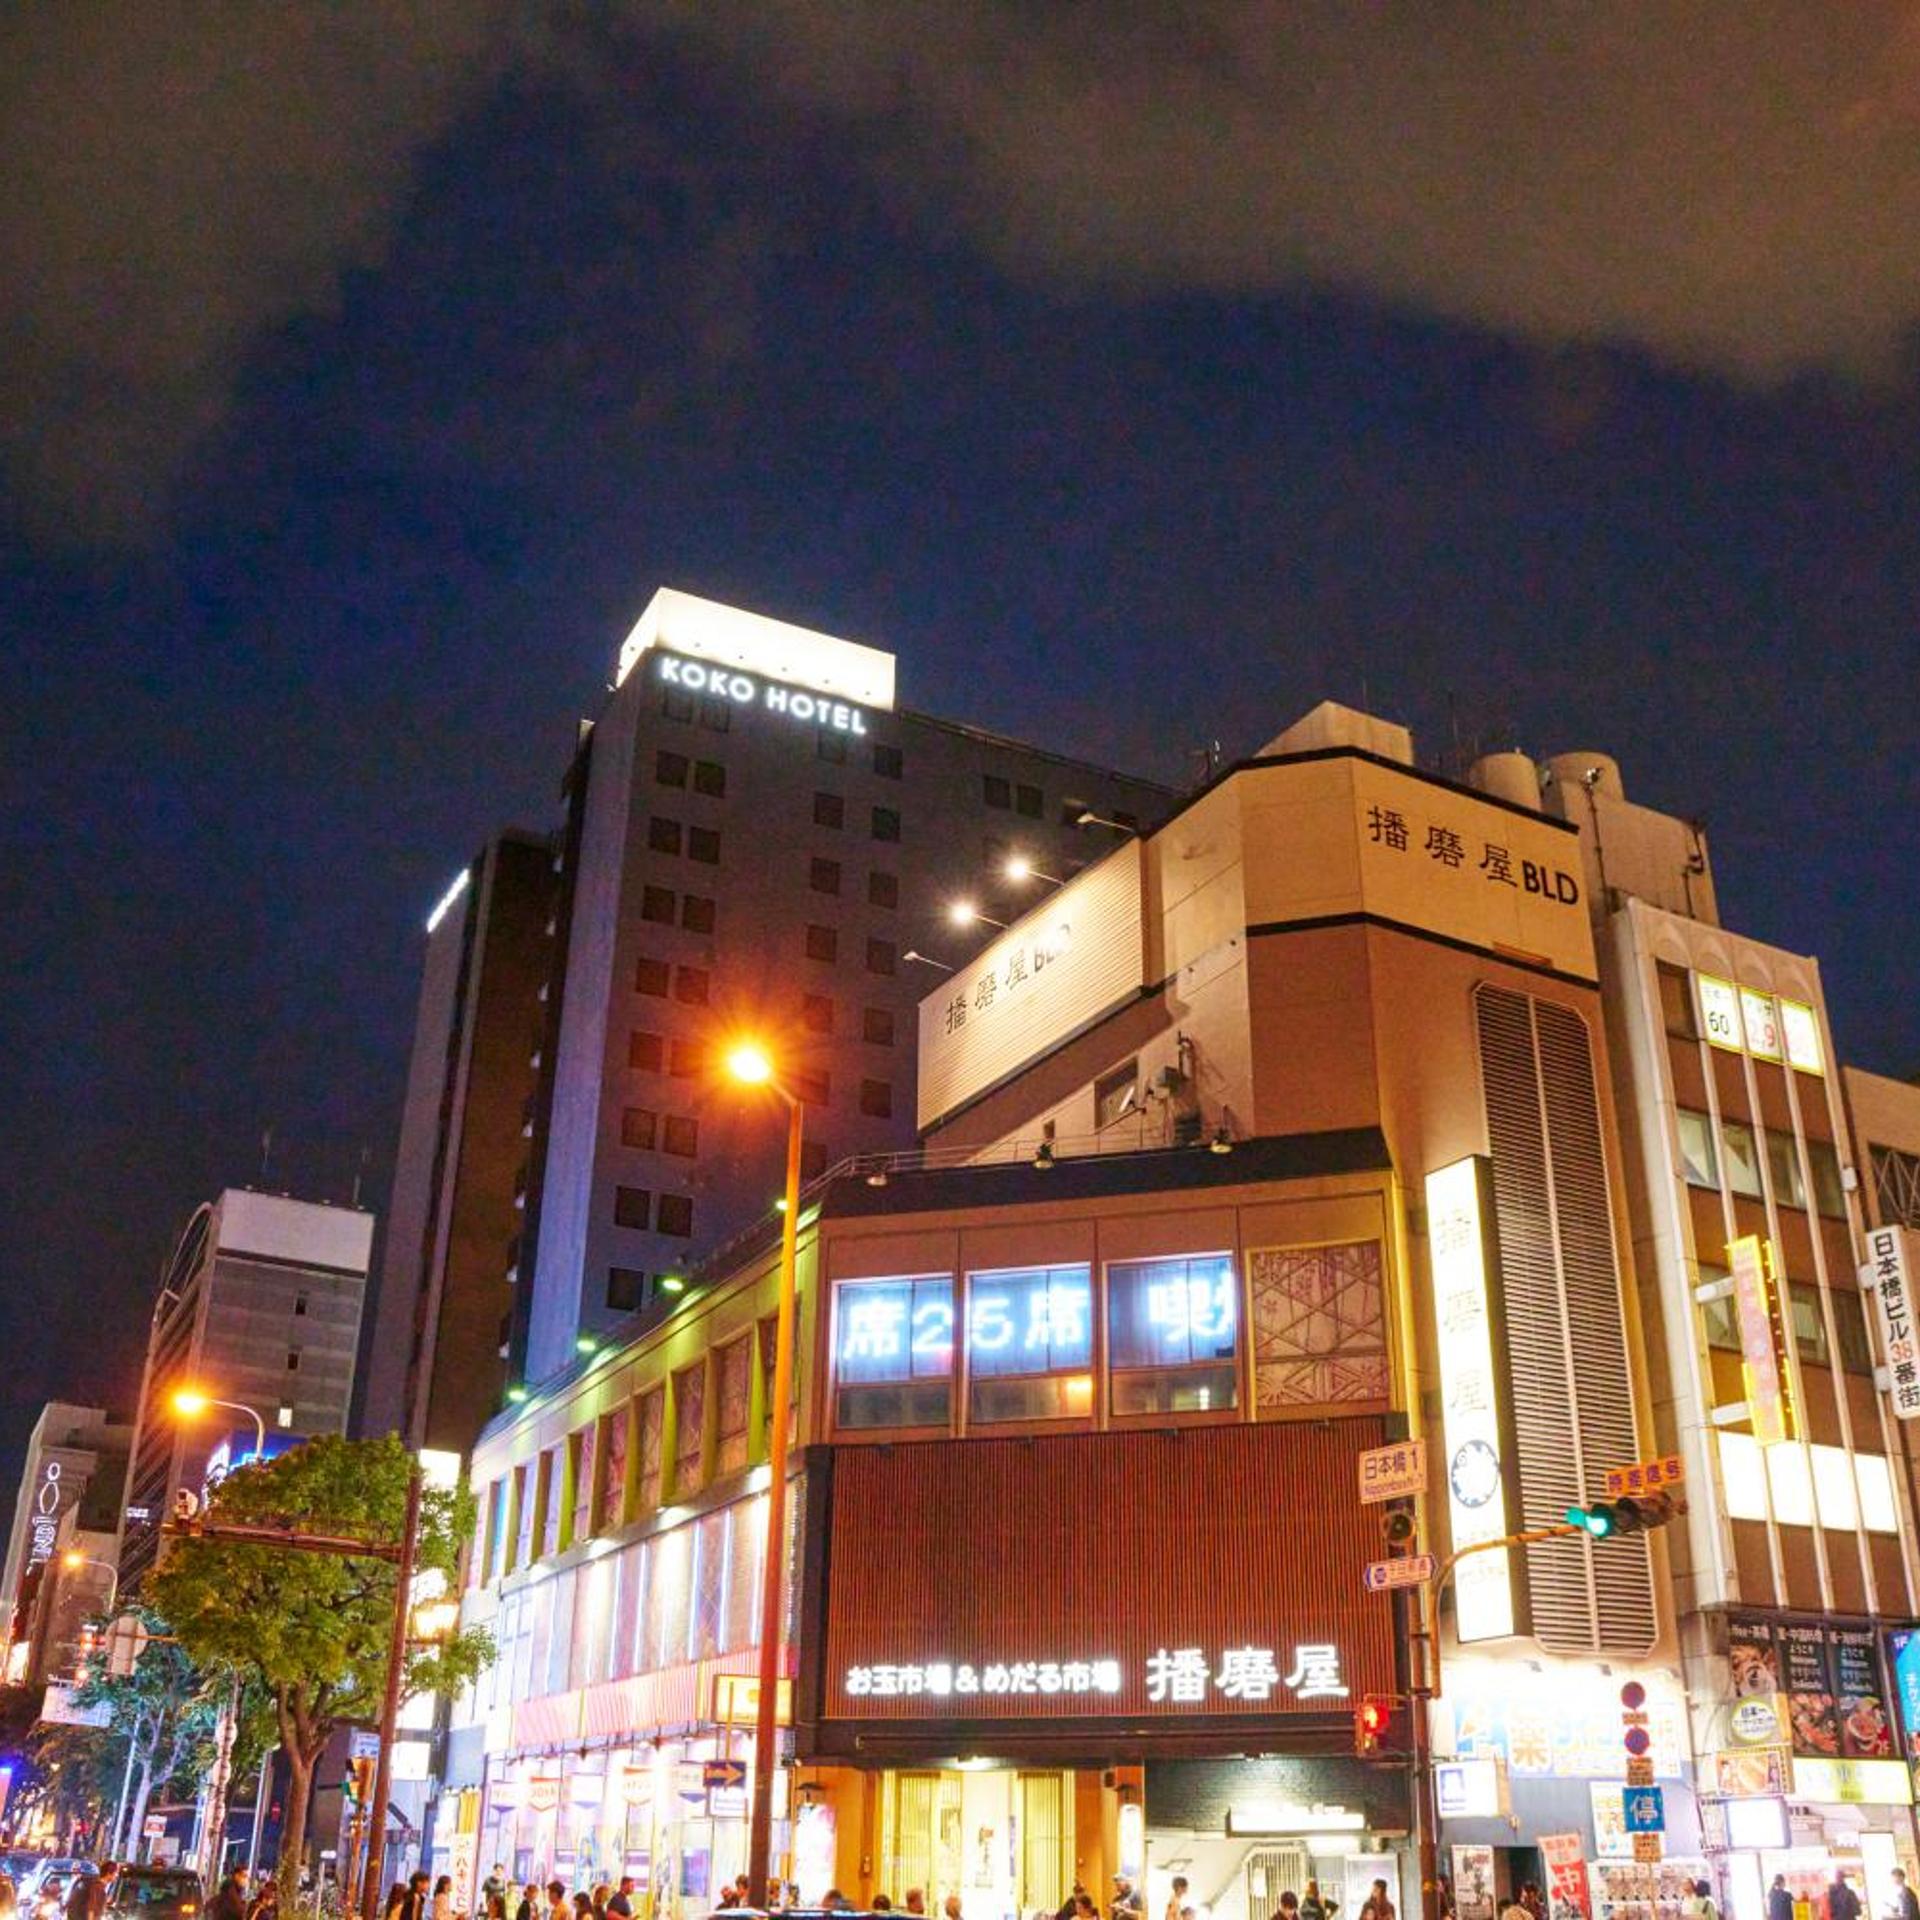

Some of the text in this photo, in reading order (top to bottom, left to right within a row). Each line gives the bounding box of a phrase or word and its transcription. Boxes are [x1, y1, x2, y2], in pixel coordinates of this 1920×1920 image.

[661, 656, 867, 735] KOKO HOTEL
[1146, 1644, 1350, 1702] 播磨屋
